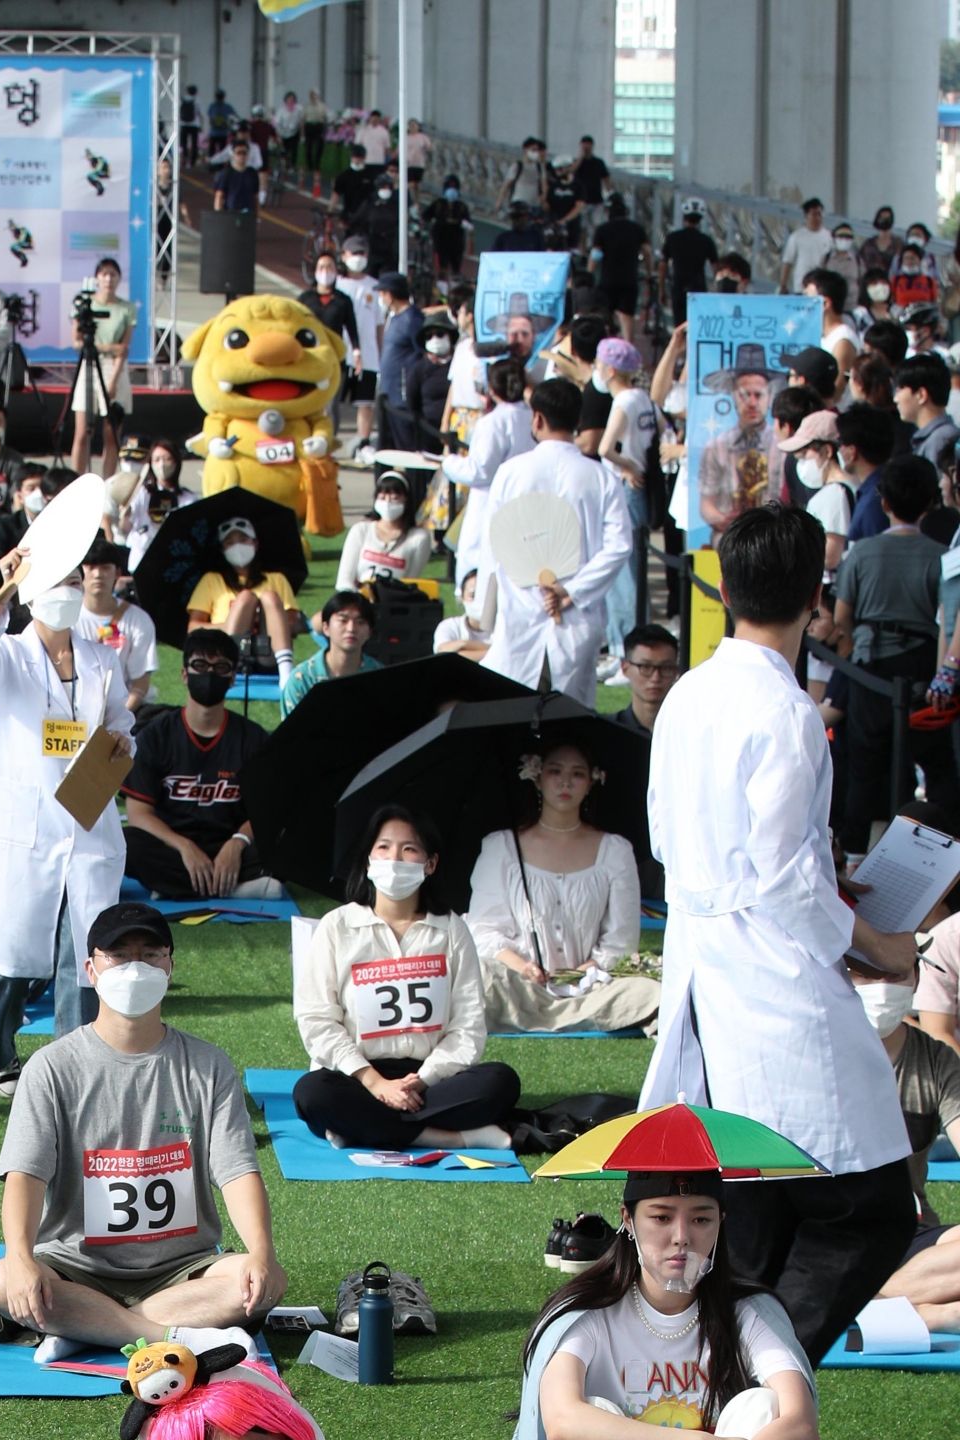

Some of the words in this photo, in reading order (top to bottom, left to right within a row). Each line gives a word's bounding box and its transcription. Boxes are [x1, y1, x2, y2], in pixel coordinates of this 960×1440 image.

[265, 446, 292, 461] 04
[355, 966, 381, 981] 2022
[375, 982, 433, 1027] 35
[88, 1155, 117, 1172] 2022
[118, 1157, 134, 1168] 한강
[136, 1152, 169, 1168] 멍때리기
[170, 1149, 185, 1161] 대회
[107, 1178, 176, 1233] 39
